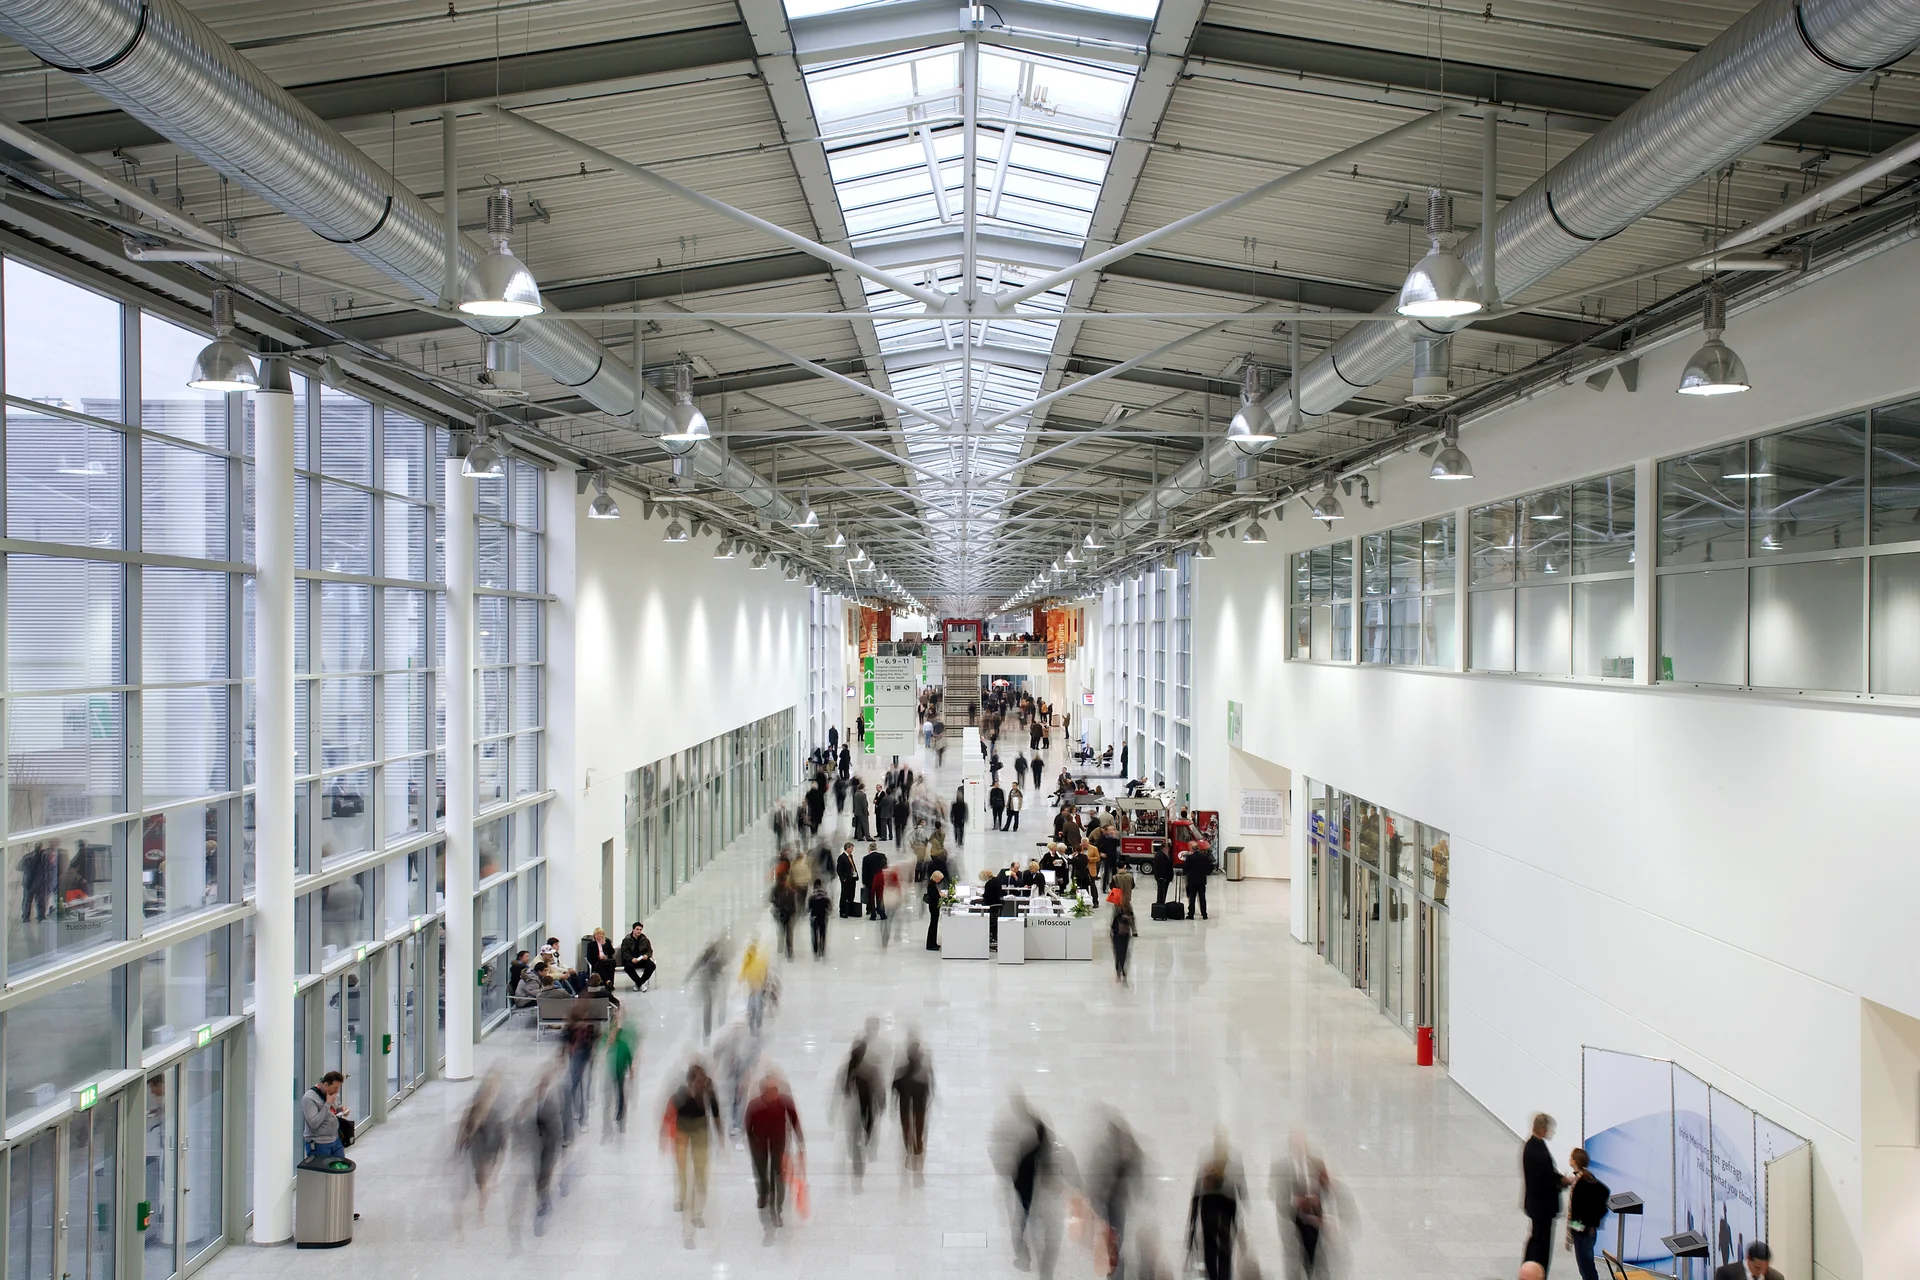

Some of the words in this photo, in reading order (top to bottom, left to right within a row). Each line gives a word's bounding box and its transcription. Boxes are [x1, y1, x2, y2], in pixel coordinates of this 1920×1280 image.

[1679, 1126, 1689, 1141] Ihre
[1689, 1134, 1710, 1160] Meinung
[1722, 1159, 1742, 1182] gefragt
[1696, 1157, 1705, 1173] Tell
[1714, 1172, 1727, 1190] what
[1727, 1182, 1738, 1197] you
[1738, 1190, 1753, 1208] think
